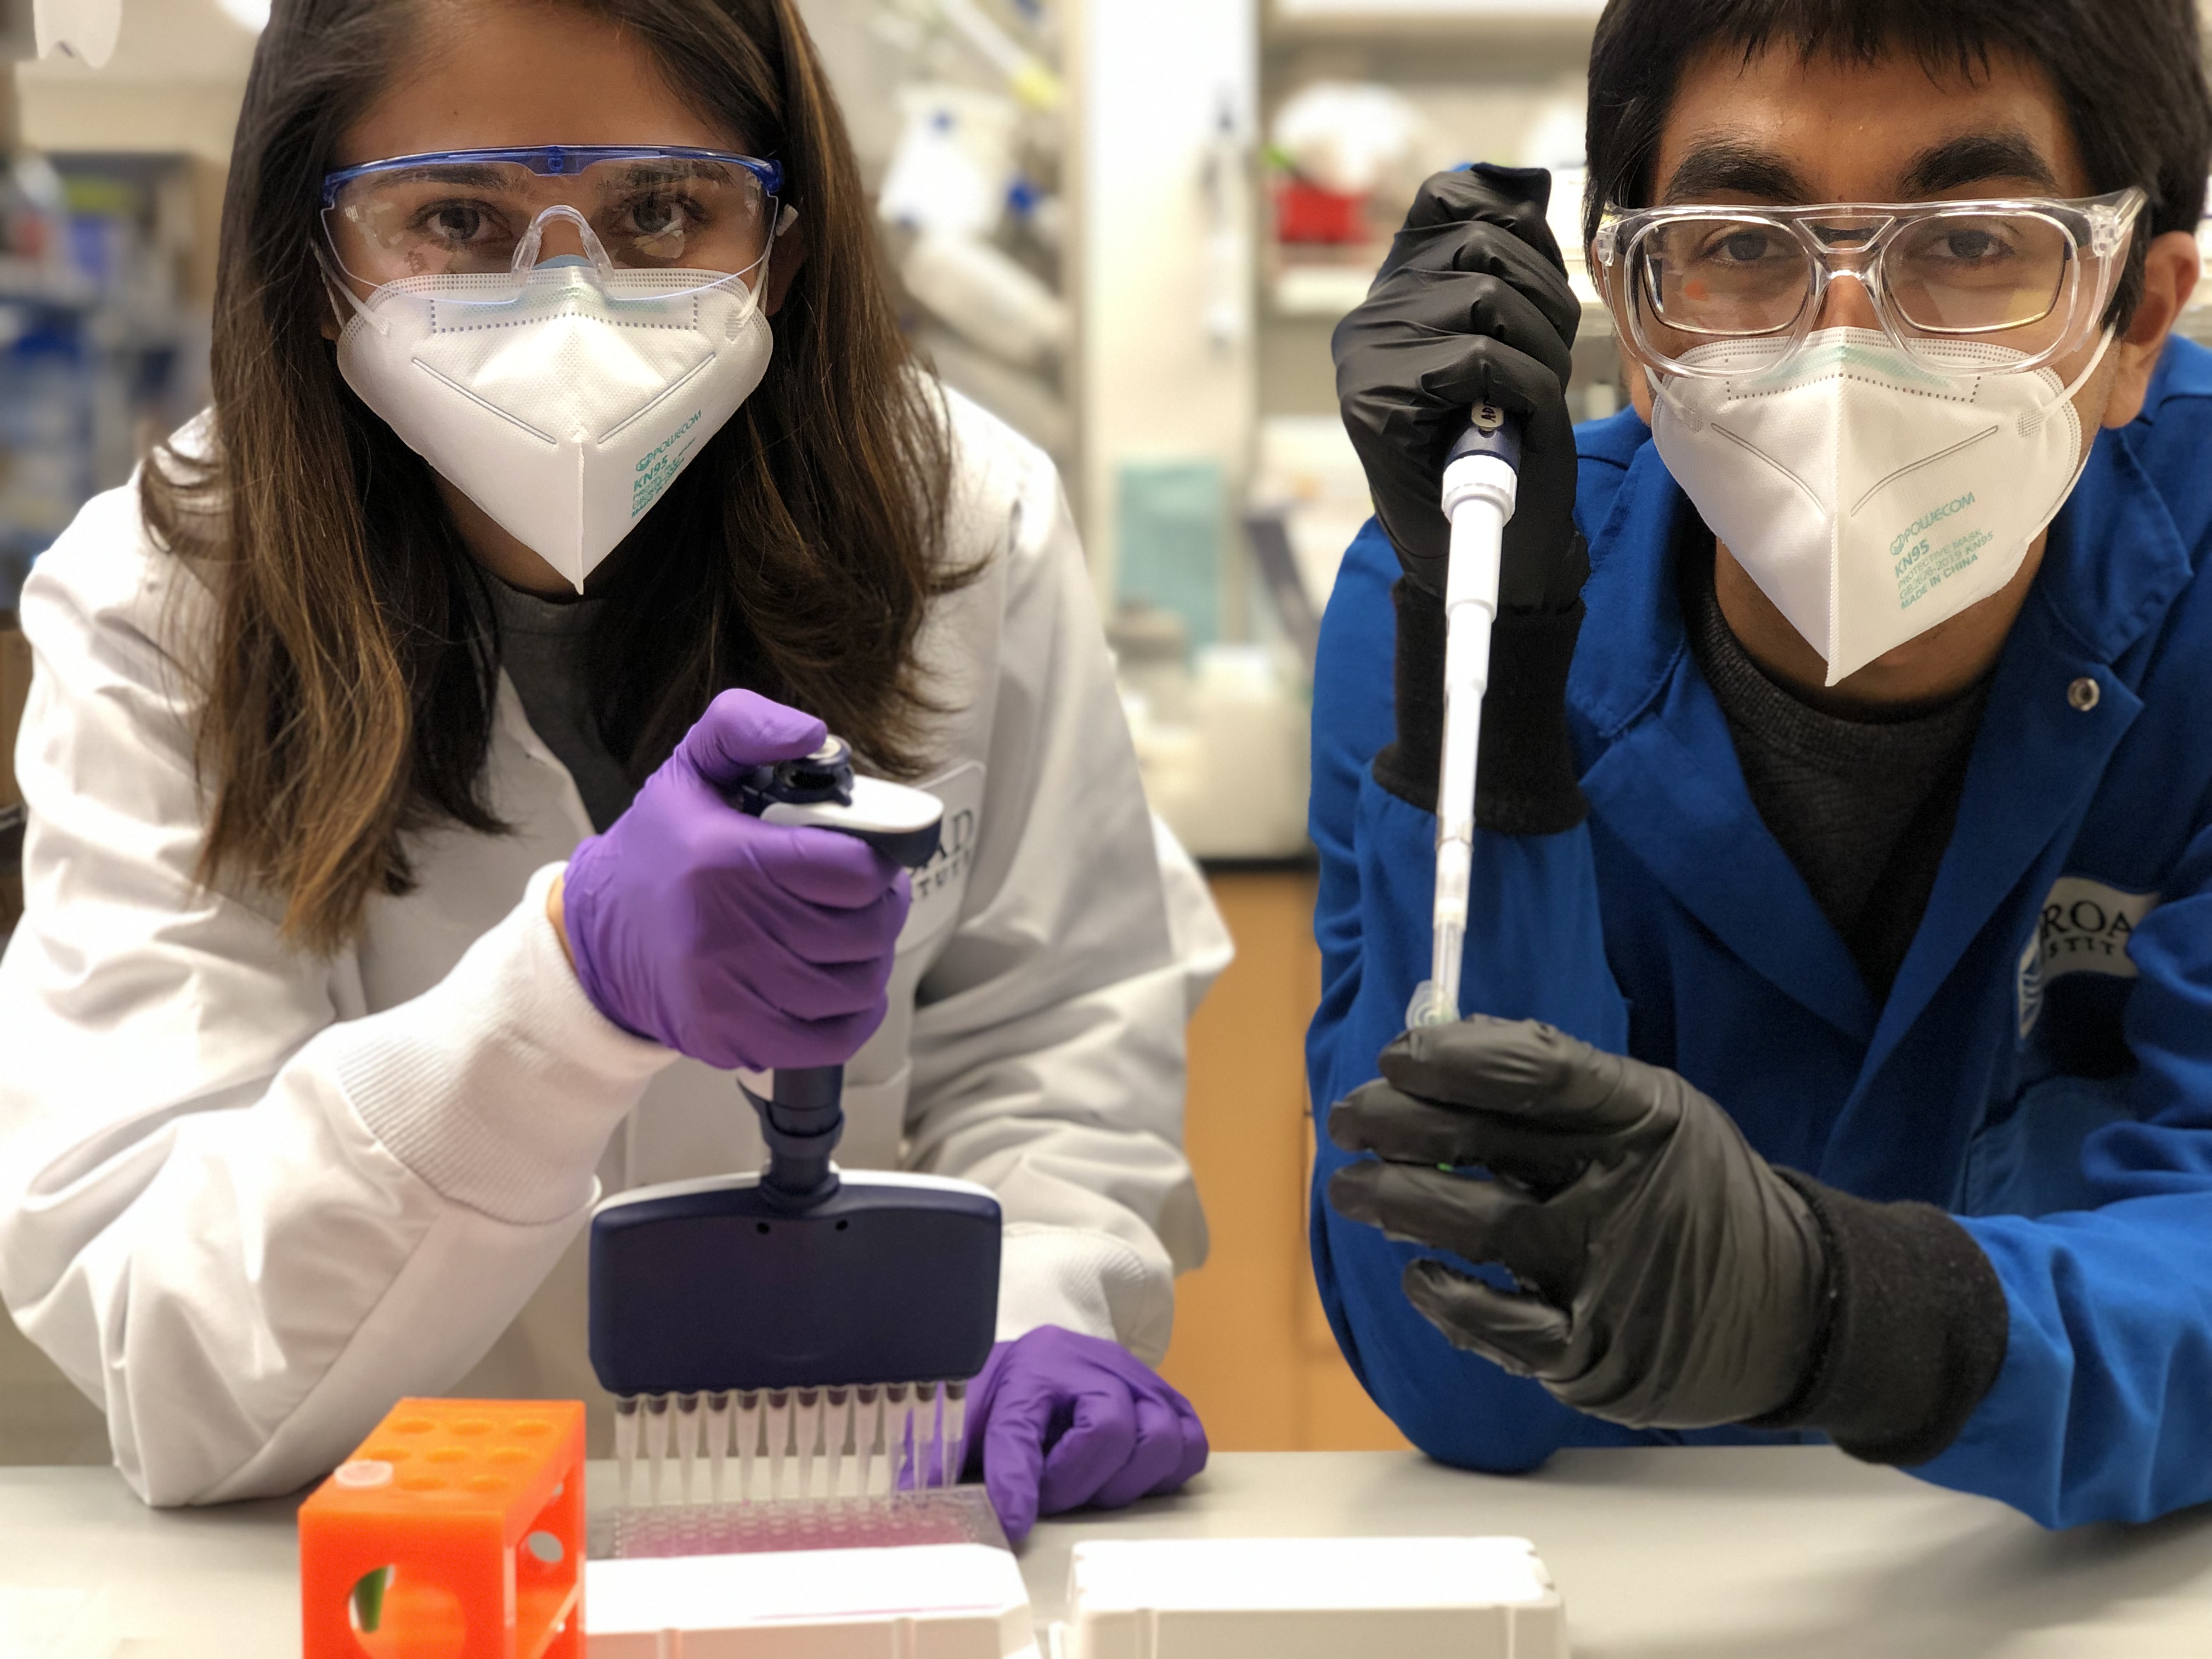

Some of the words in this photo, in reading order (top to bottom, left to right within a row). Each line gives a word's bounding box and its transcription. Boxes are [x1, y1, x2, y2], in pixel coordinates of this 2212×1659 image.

[634, 455, 668, 492] KN95
[1904, 492, 1976, 543] POWECOM
[1895, 538, 1930, 578] KN95
[1898, 546, 1951, 589] PROTECTIVE
[1952, 529, 1983, 549] MASK
[1966, 530, 1994, 555] KN95
[1901, 583, 1929, 609] MADE
[1929, 574, 1942, 588] IN
[1943, 554, 1979, 578] CHINA
[2042, 900, 2133, 939] ROA
